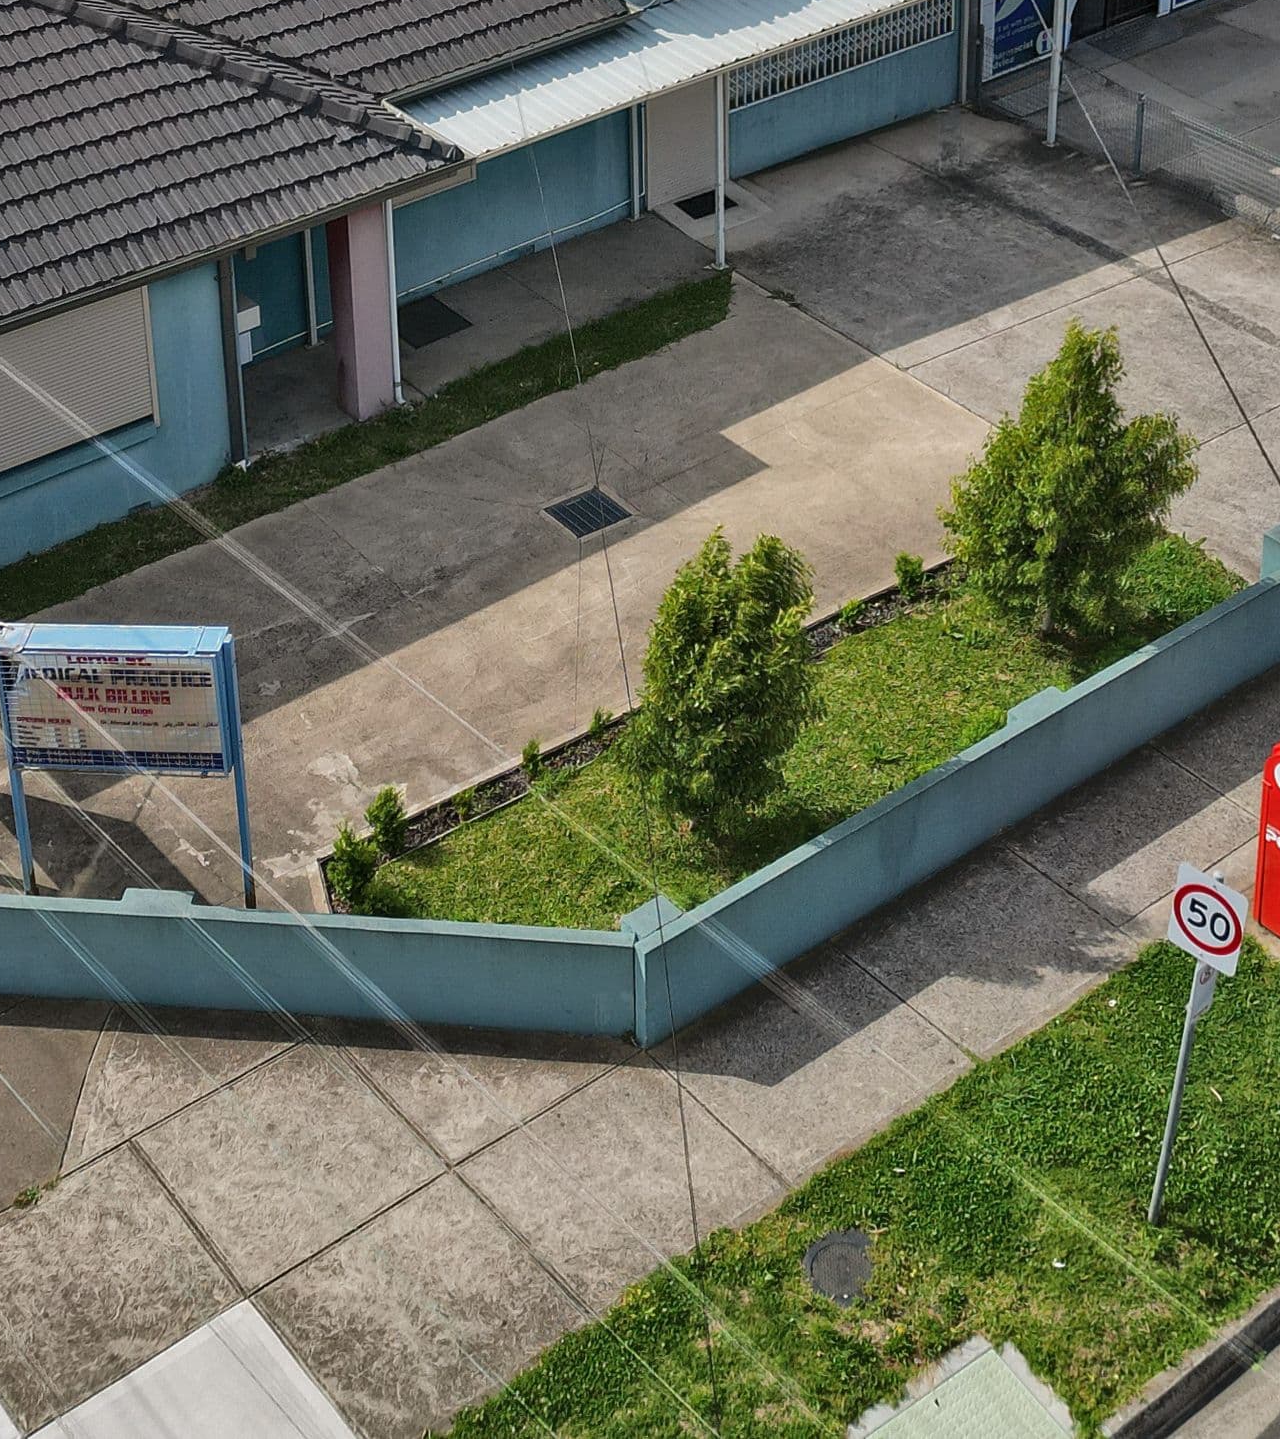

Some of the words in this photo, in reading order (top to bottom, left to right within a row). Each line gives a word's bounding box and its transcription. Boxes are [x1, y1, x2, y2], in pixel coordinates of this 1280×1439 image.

[110, 668, 213, 688] PRACTICE
[56, 685, 101, 703] BULK
[104, 687, 171, 705] BILLING
[1188, 898, 1231, 942] 50
